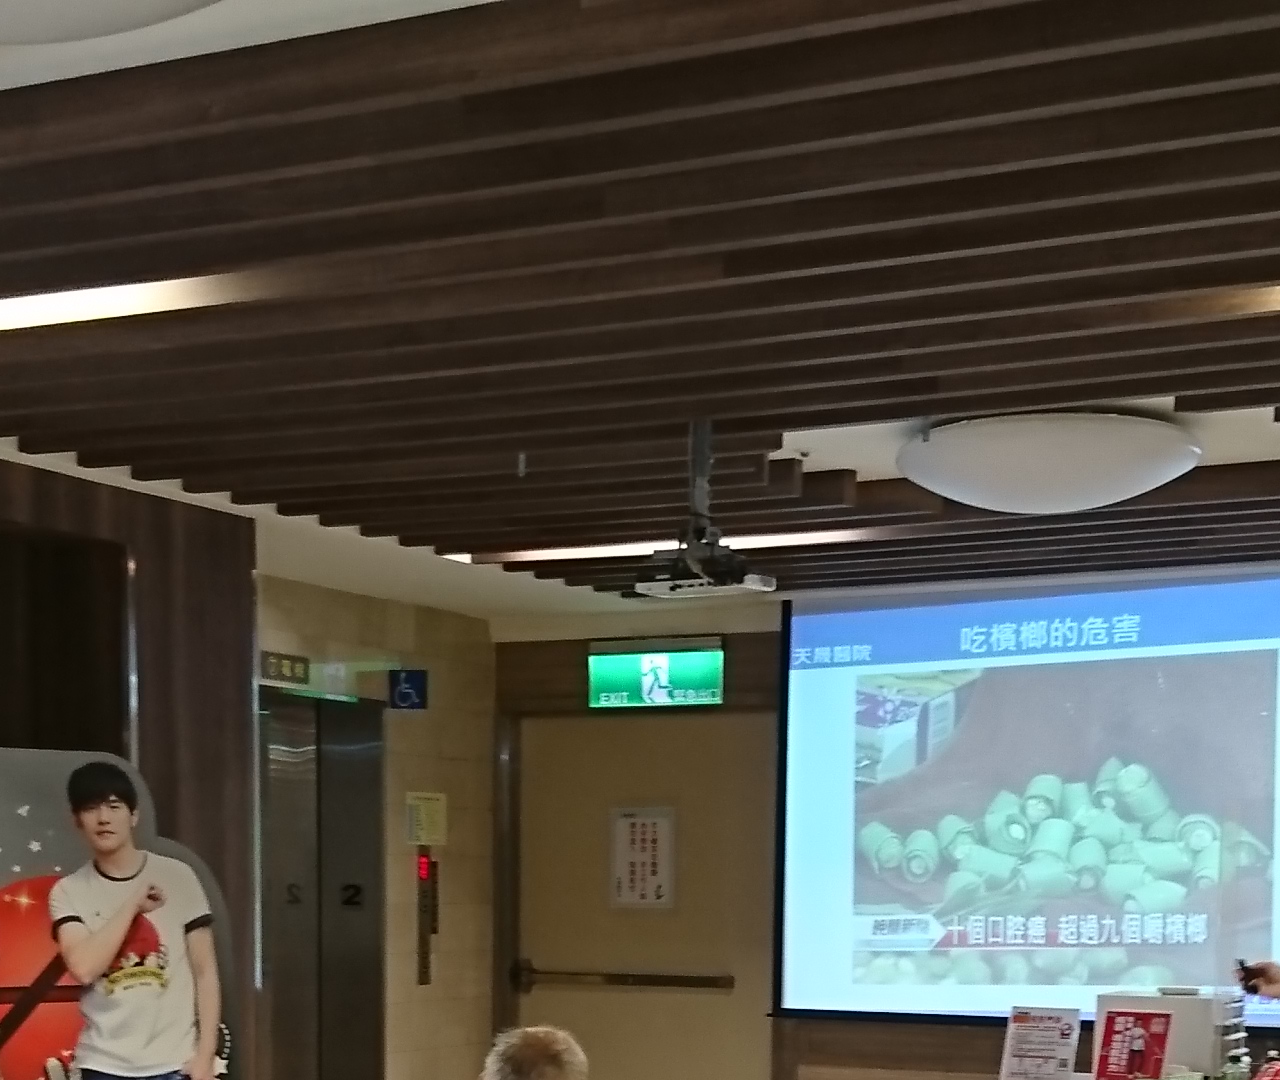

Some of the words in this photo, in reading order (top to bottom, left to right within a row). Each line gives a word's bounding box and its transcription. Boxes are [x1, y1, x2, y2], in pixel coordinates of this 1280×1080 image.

[960, 613, 1142, 655] 吃檳榔的危害
[599, 692, 629, 704] EXIT
[341, 884, 363, 906] 2
[946, 914, 1047, 945] 十個口腔癌
